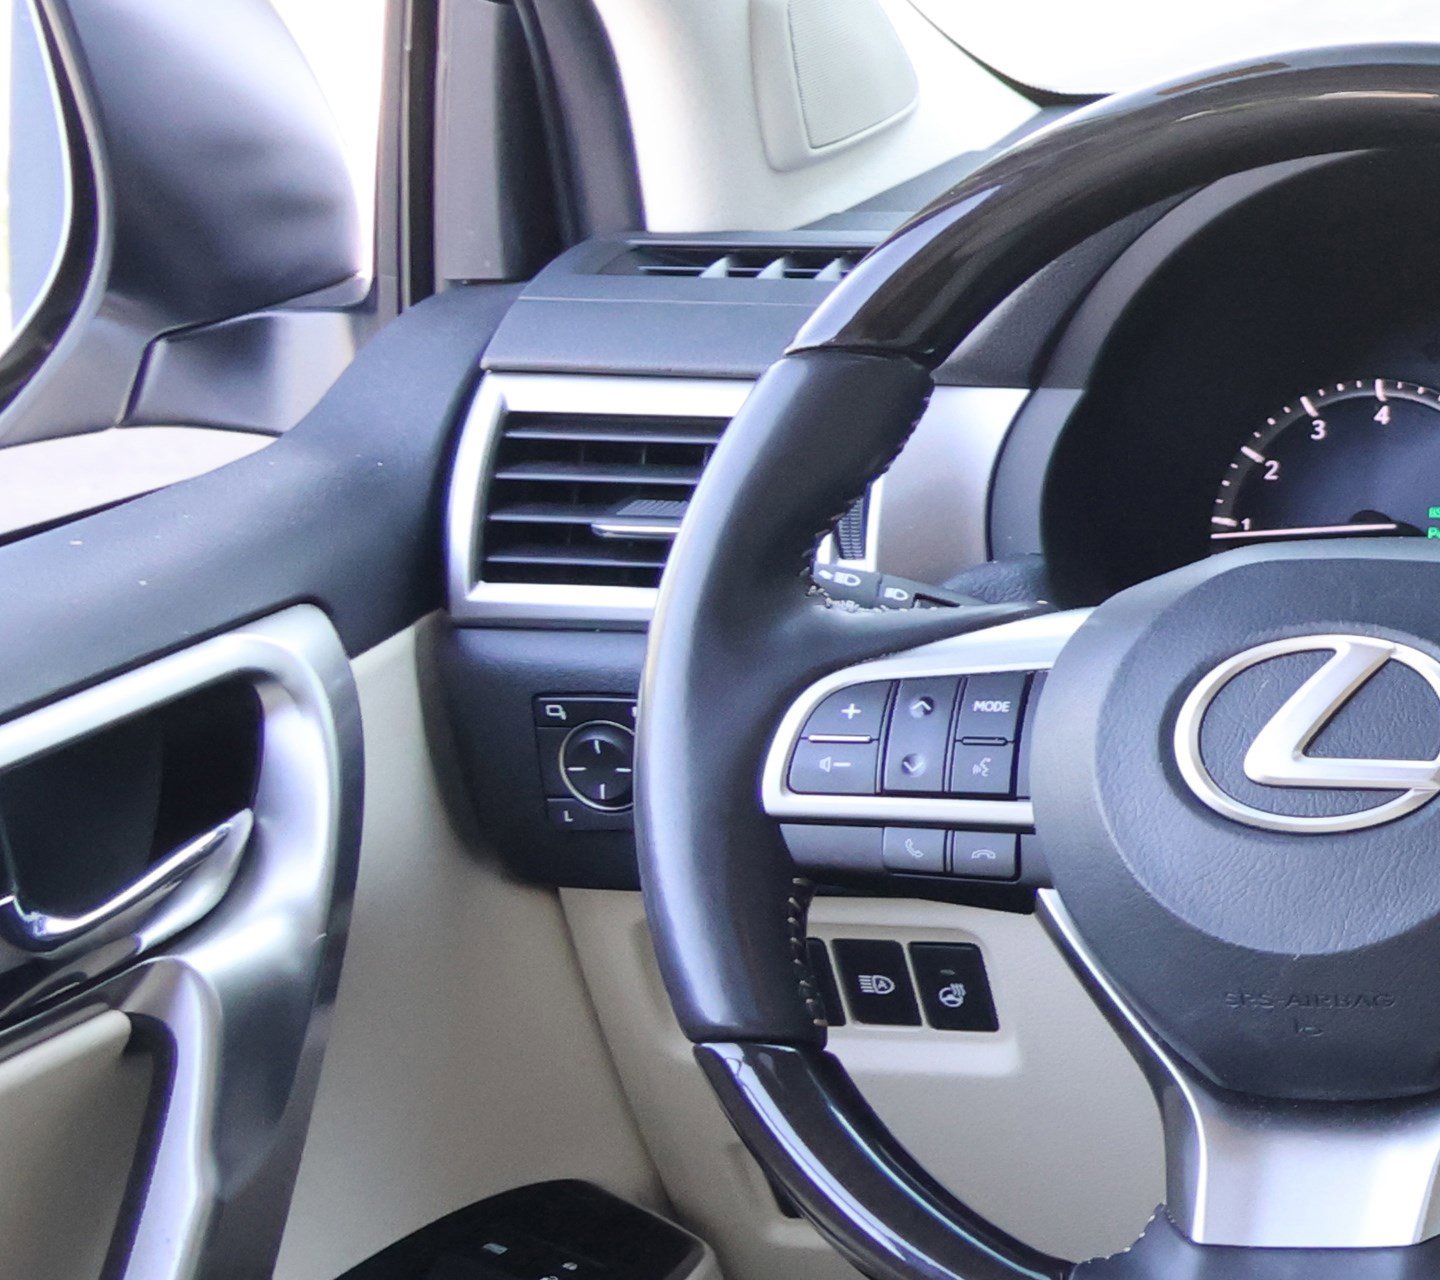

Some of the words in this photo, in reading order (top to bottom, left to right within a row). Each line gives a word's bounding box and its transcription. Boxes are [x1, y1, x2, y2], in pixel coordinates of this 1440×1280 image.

[1373, 406, 1391, 425] 4
[1310, 420, 1327, 440] 3
[1264, 460, 1281, 481] 2
[1241, 518, 1251, 531] 1
[973, 700, 1010, 714] MODE
[563, 809, 574, 823] L
